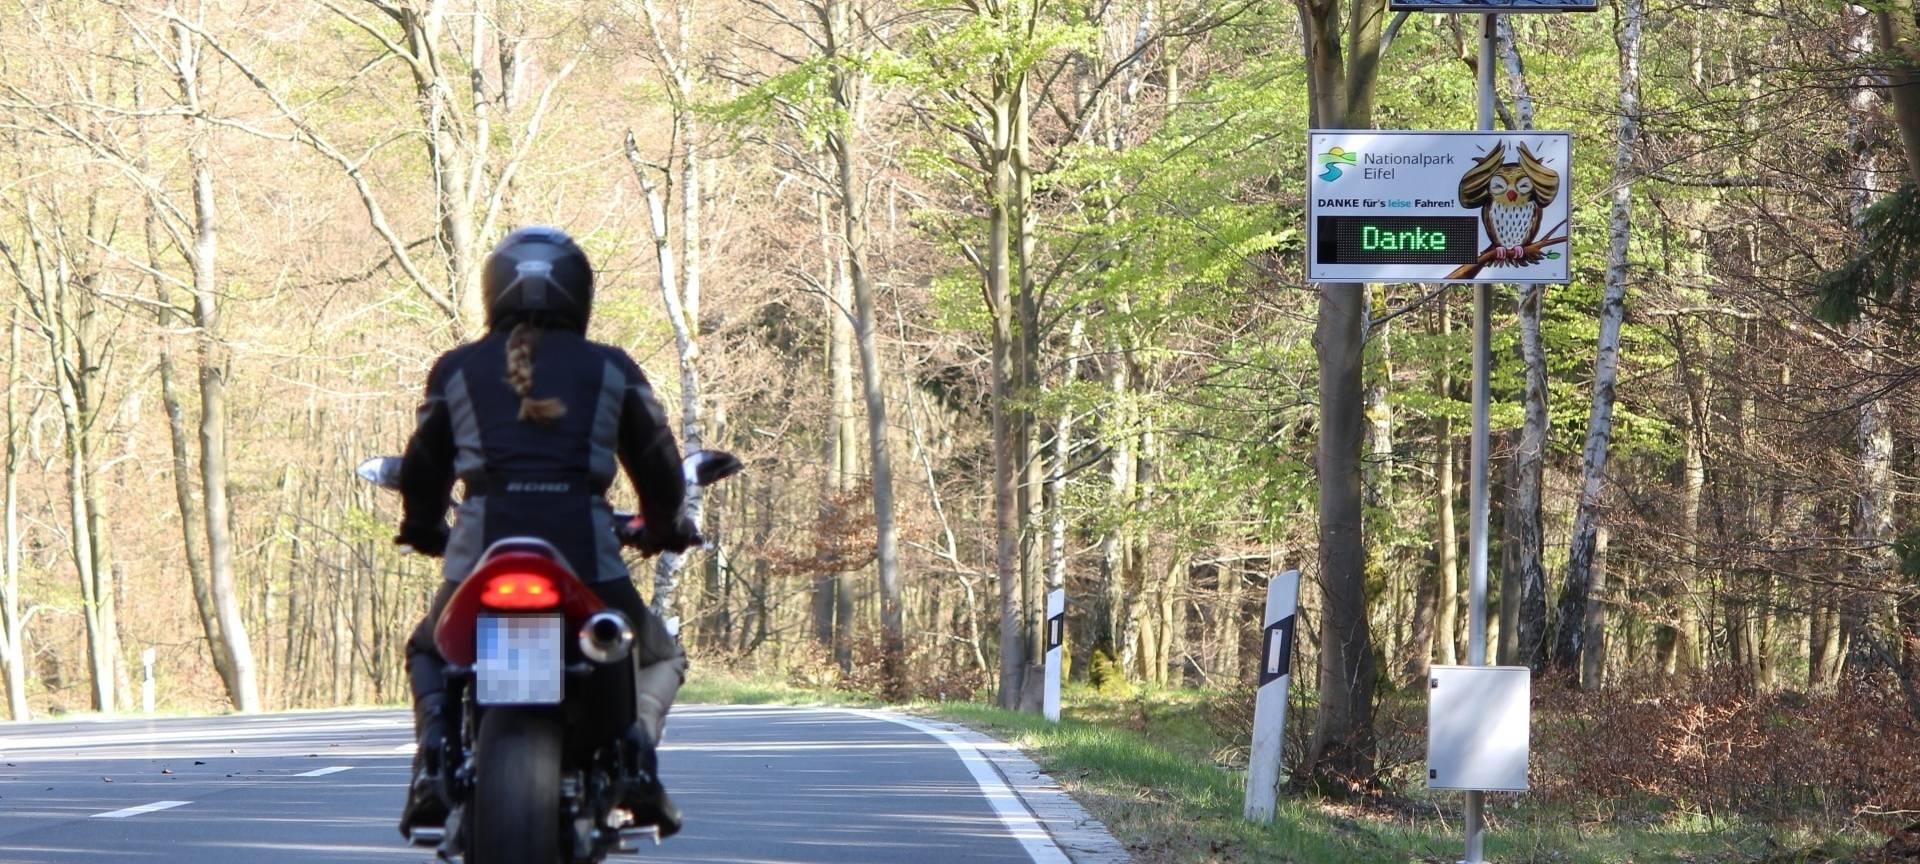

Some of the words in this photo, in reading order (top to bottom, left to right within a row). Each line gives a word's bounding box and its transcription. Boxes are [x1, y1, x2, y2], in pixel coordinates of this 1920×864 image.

[1364, 153, 1455, 168] Nationalpark
[1364, 168, 1395, 180] Eifel
[1318, 199, 1360, 208] DANKE
[1363, 198, 1386, 208] für's
[1388, 199, 1412, 208] leise
[1415, 199, 1455, 208] Fahren!
[1362, 226, 1446, 250] Danke
